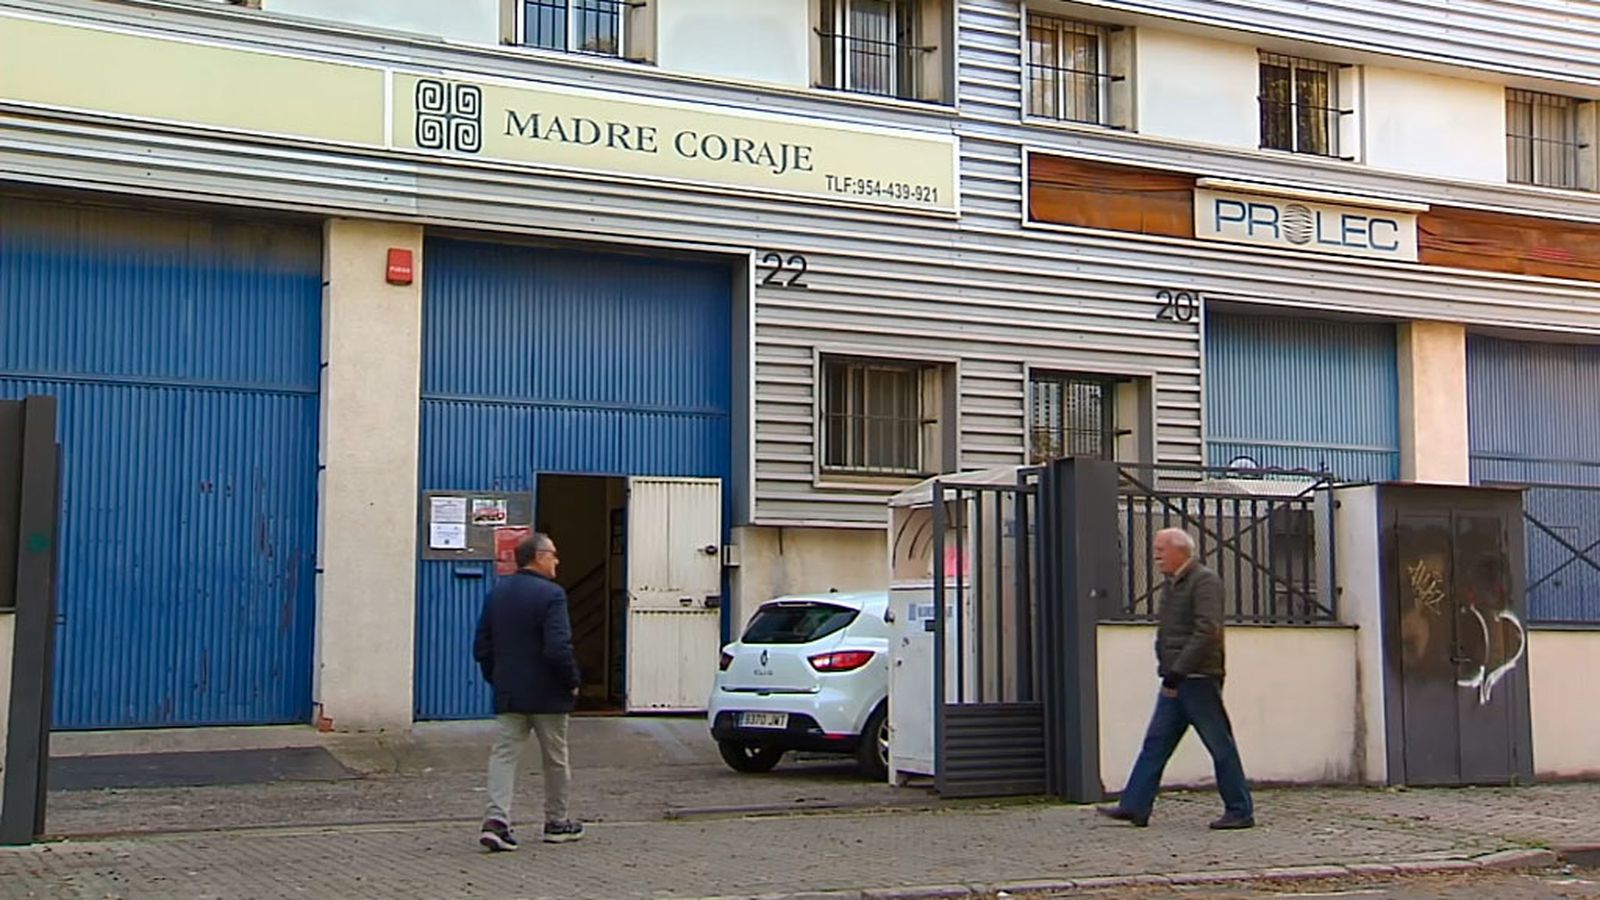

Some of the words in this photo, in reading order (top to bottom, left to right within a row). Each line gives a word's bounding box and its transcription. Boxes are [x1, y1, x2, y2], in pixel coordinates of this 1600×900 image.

[503, 110, 657, 154] MADRE
[674, 131, 814, 175] CORAJE
[825, 175, 939, 203] TLF:954-439-921
[1215, 199, 1399, 251] PROLEC
[761, 253, 808, 288] 22
[1155, 290, 1194, 321] 20
